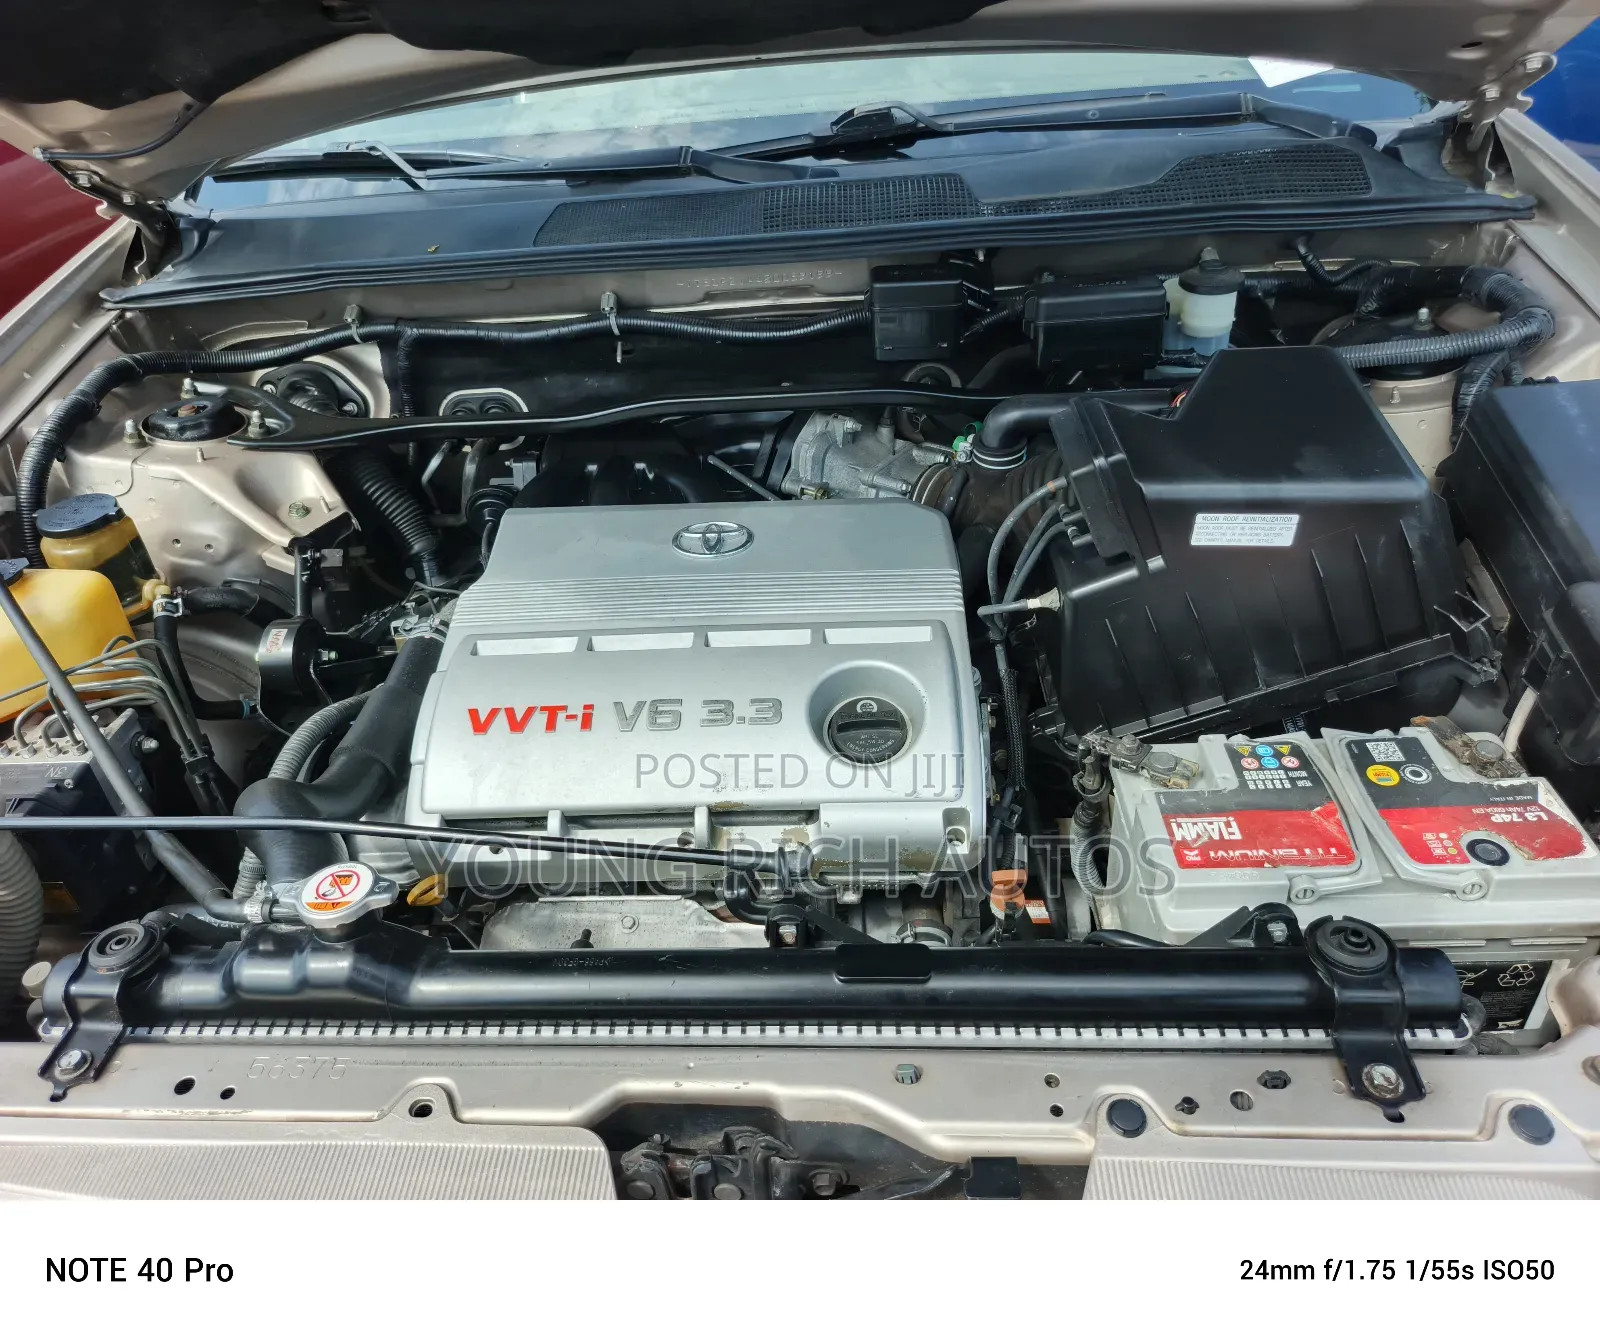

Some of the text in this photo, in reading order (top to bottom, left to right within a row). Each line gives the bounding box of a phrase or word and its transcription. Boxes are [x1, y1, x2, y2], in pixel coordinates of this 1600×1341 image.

[467, 697, 783, 736] VVT-i V6 3.3
[1489, 811, 1550, 823] L3 74P
[1171, 821, 1243, 842] FIAMM
